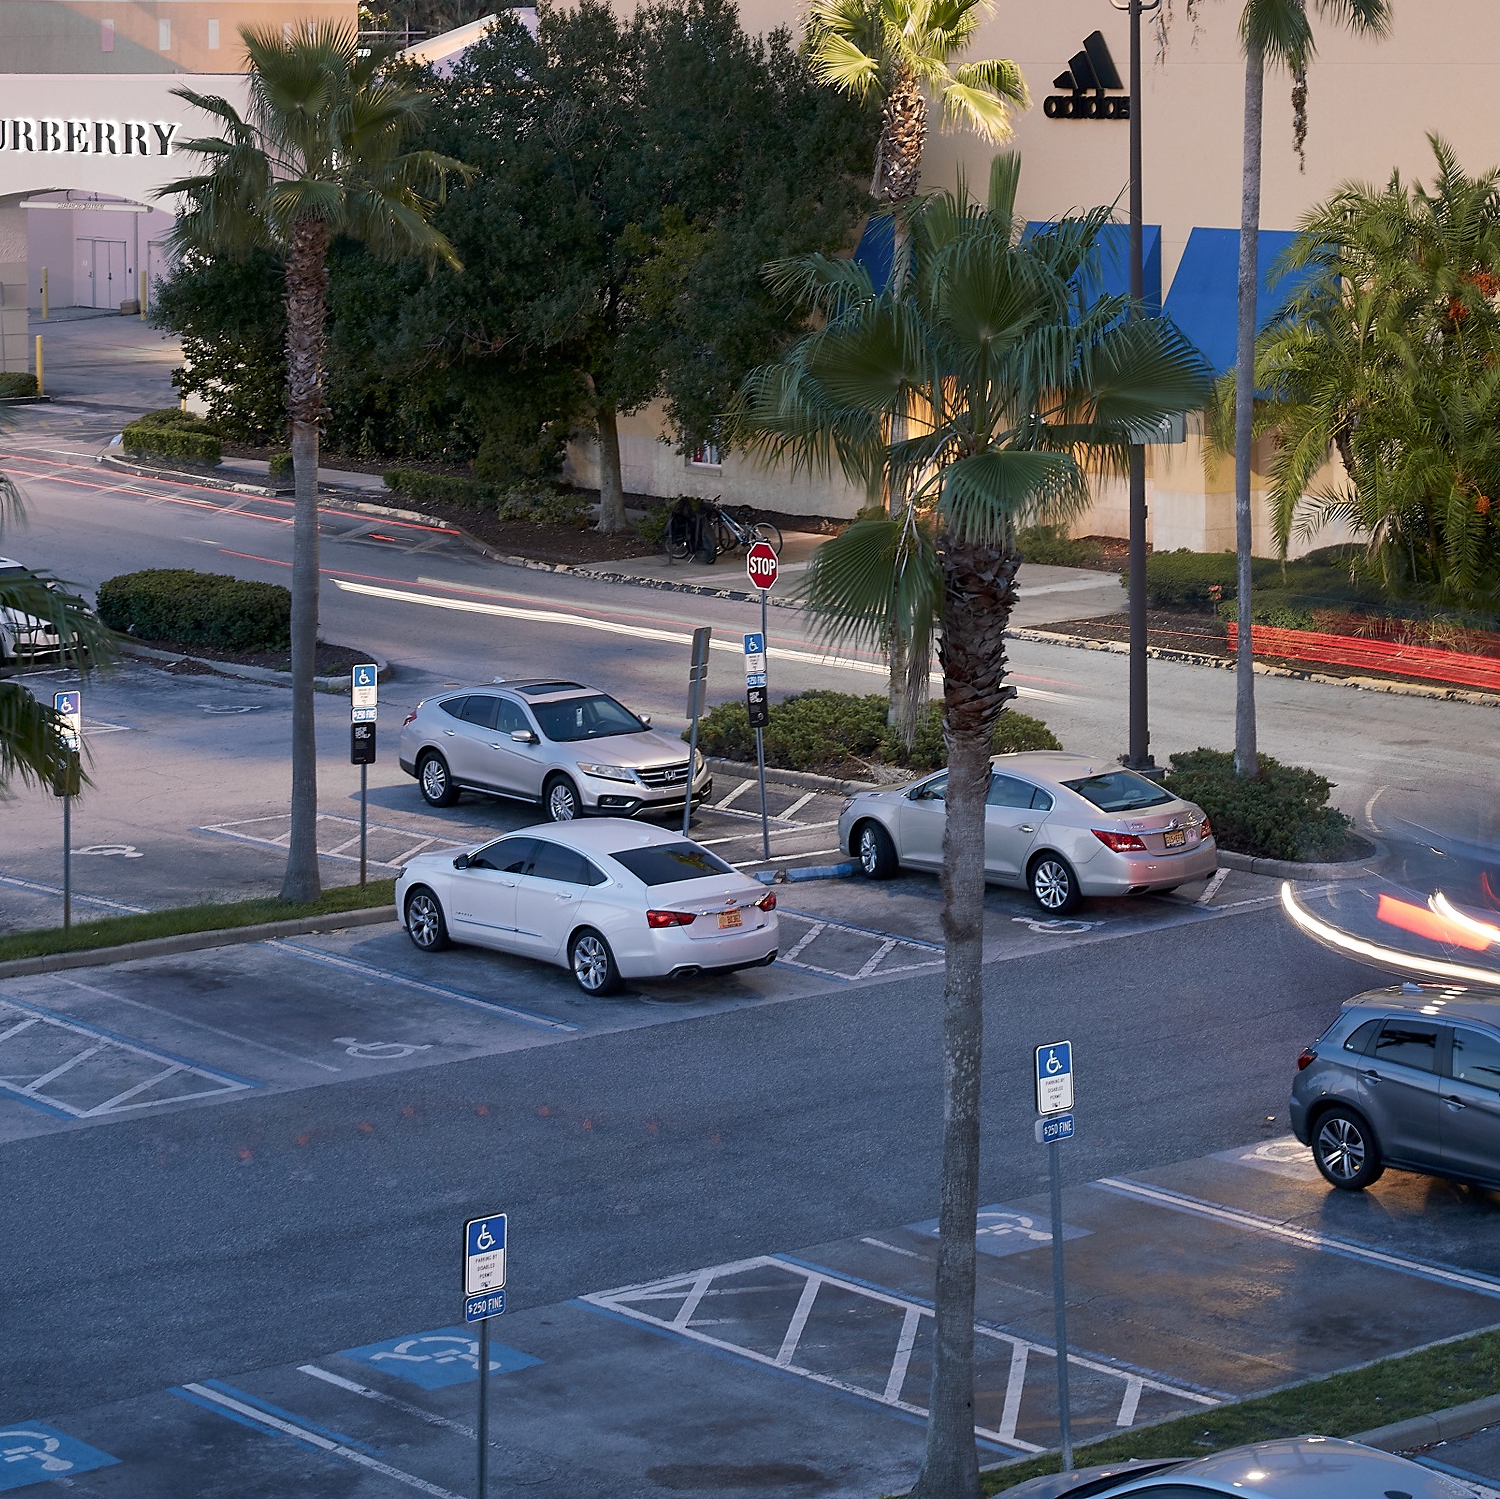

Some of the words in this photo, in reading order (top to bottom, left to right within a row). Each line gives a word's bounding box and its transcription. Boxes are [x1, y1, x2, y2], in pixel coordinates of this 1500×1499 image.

[749, 556, 776, 576] STOP
[1044, 1123, 1058, 1136] $250
[1059, 1120, 1072, 1133] FINE
[468, 1300, 486, 1314] $250
[488, 1296, 503, 1309] FINE
